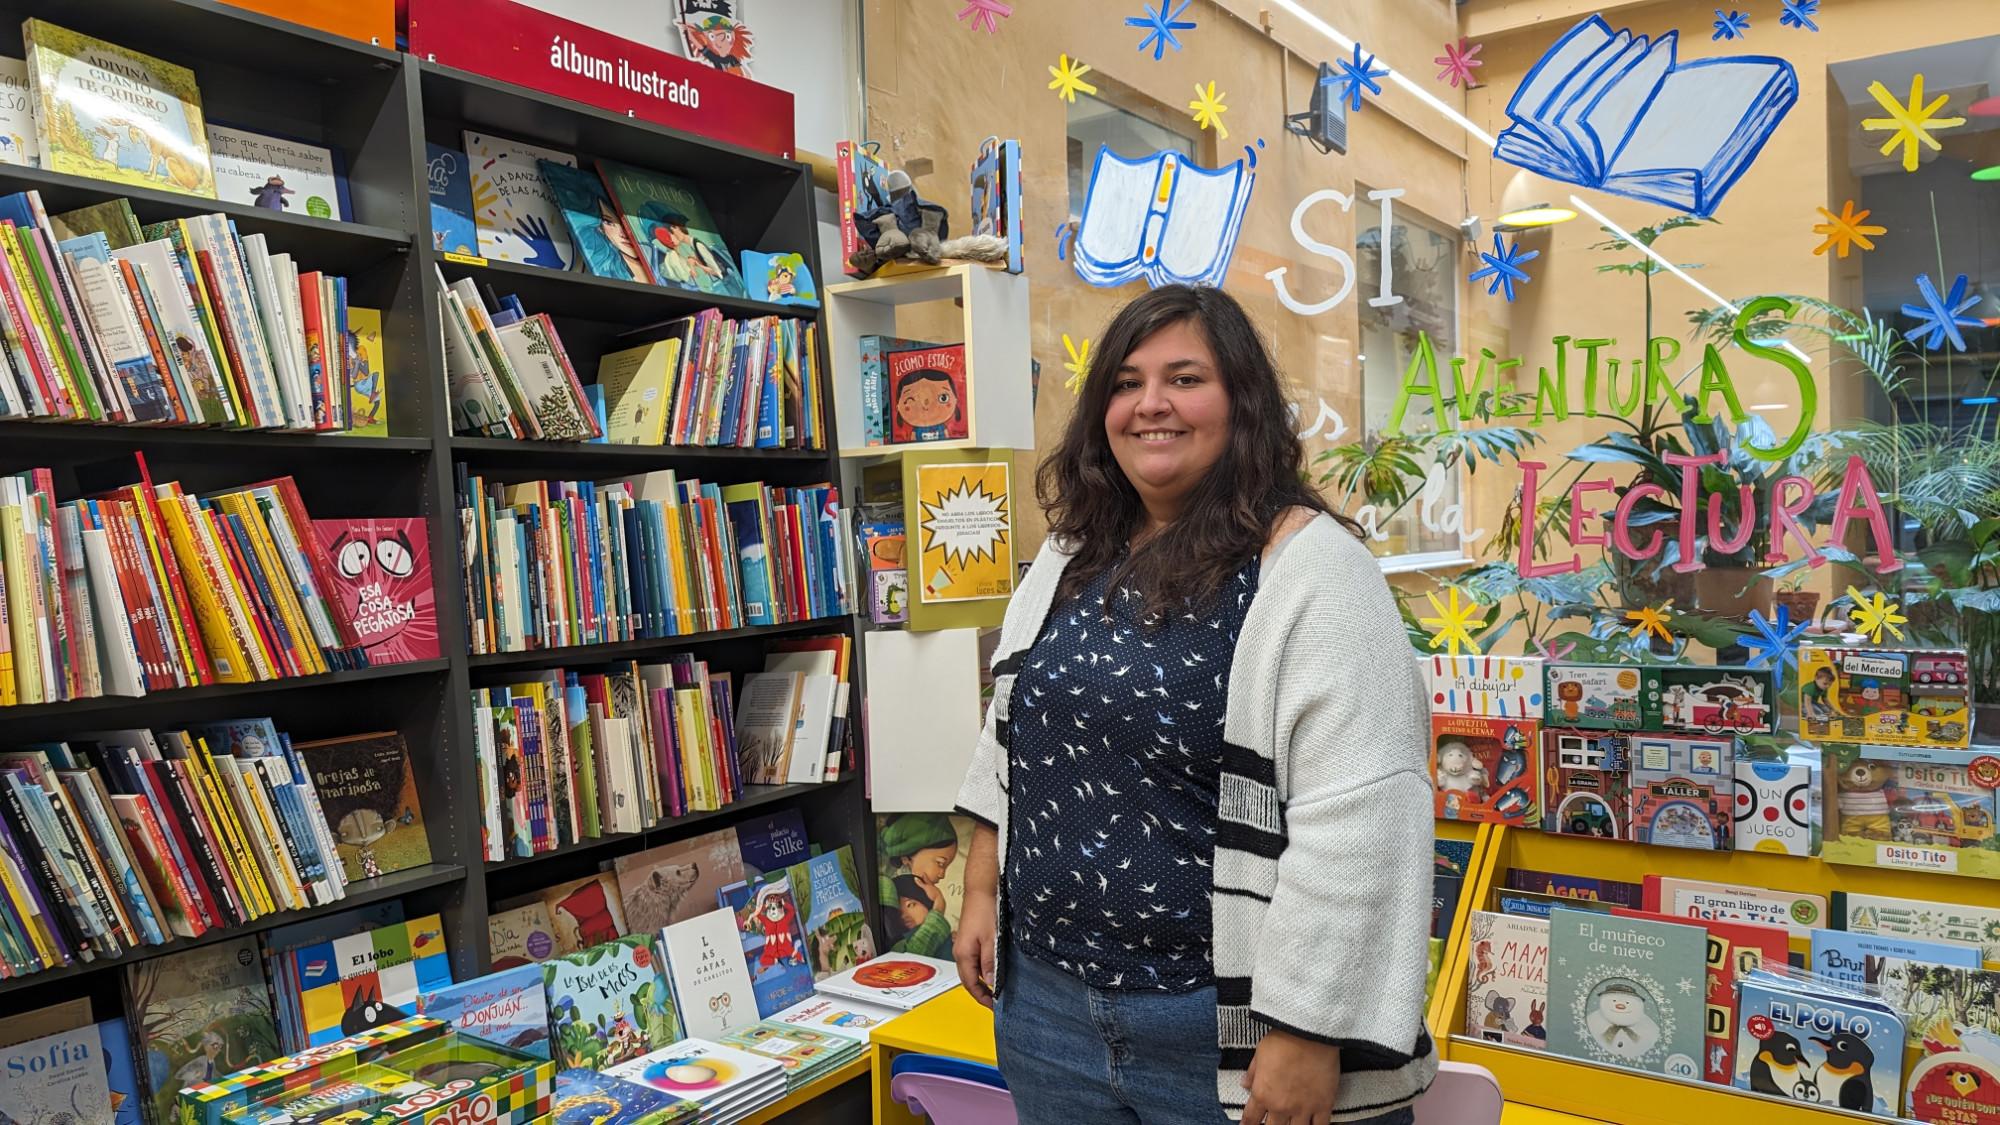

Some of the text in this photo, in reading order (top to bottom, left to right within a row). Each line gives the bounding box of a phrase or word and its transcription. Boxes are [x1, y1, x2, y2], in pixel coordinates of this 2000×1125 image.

[88, 55, 150, 82] ADIVINA
[550, 35, 700, 109] álbum ilustrado
[74, 76, 97, 92] TE
[102, 84, 168, 114] QUIERO
[213, 133, 236, 149] topo
[240, 138, 258, 152] que
[298, 150, 324, 163] saber
[491, 172, 543, 187] LA DANZA
[498, 186, 530, 197] DE LAS
[1264, 187, 1407, 315] SI
[1381, 296, 1818, 461] AVENTURAS
[1421, 462, 1485, 542] la
[1517, 448, 1903, 578] LECTURA
[358, 582, 382, 602] ESA
[358, 596, 393, 617] COSA
[353, 602, 415, 638] PEGAJOSA
[1569, 671, 1588, 679] Tren
[1845, 663, 1901, 676] del Mercado
[1470, 675, 1517, 699] dibujar!
[1582, 678, 1607, 687] safari
[316, 767, 375, 786] Orejas de
[1905, 766, 1945, 782] Osito
[320, 780, 382, 800] mariposa
[1661, 786, 1700, 798] TALLER
[1759, 787, 1782, 800] UN
[1746, 824, 1795, 838] JUEGO
[773, 836, 804, 857] Silke
[1886, 847, 1947, 862] Osito Tito
[813, 861, 834, 879] NADA
[816, 884, 844, 905] PARECE
[1545, 881, 1599, 901] ÁGATA
[1694, 895, 1785, 915] El gran libro de
[1579, 922, 1666, 948] El muñeco
[351, 947, 395, 966] El lobo
[702, 949, 716, 961] AS
[1500, 941, 1548, 965] MAM
[1588, 938, 1655, 960] de nieve
[696, 959, 727, 975] GAFAS
[576, 972, 598, 993] ISLA
[480, 1021, 512, 1037] del mar
[1769, 1001, 1873, 1040] EL POLO
[7, 1040, 89, 1080] Sofía
[1670, 1062, 1691, 1077] 40
[1941, 1107, 1979, 1124] ESTAS
